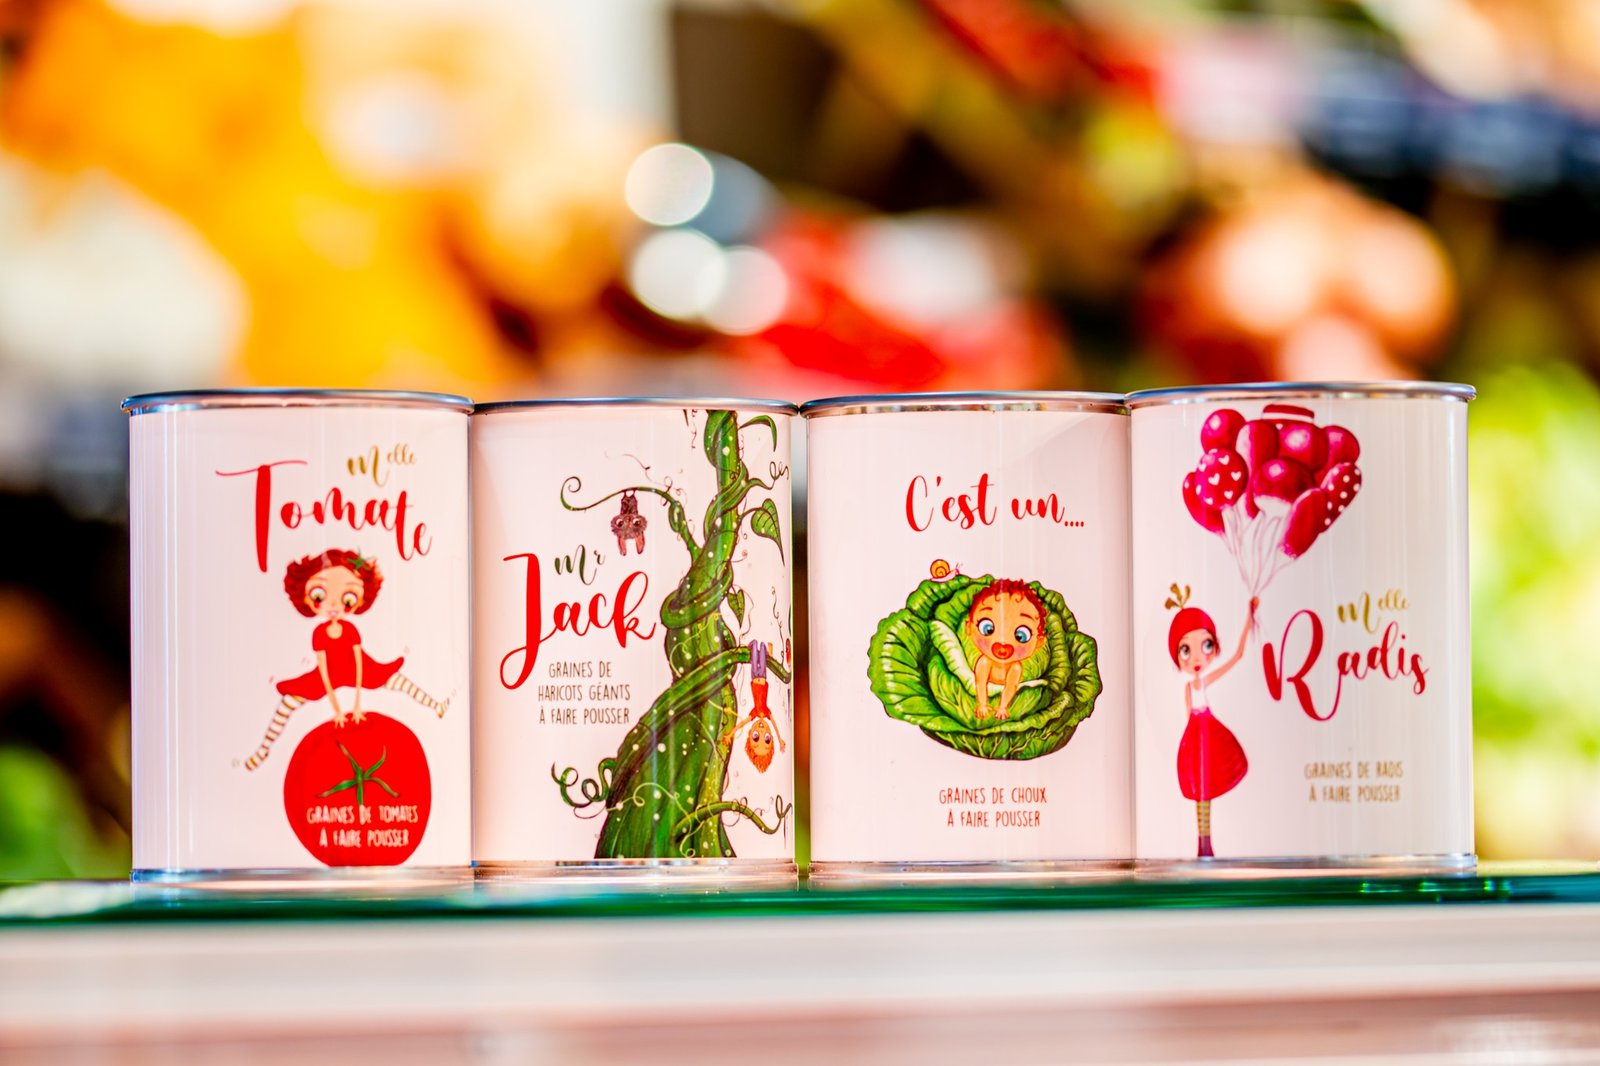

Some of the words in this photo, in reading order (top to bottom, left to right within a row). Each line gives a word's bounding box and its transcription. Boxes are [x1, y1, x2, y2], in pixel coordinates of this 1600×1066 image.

[905, 473, 997, 532] C'est
[215, 460, 432, 573] Tomate
[500, 553, 656, 690] Jack
[549, 660, 593, 678] GRAINES
[599, 660, 612, 678] DE
[1262, 621, 1429, 722] Radis
[538, 684, 583, 702] HARICOTS
[589, 682, 631, 701] GÉANTS
[551, 708, 577, 725] FAIRE
[584, 707, 630, 725] POUSSER
[1303, 761, 1352, 779] GRAINES
[1357, 761, 1369, 779] DE
[1375, 760, 1404, 779] RADIS
[939, 787, 986, 804] GRAINES
[992, 787, 1004, 804] DE
[1011, 787, 1047, 804] CHOUX
[1323, 784, 1351, 802] FAIRE
[1357, 784, 1400, 803] POUSSER
[306, 805, 355, 824] GRAINES
[359, 804, 371, 825] DE
[378, 805, 419, 823] TOMATES
[960, 810, 989, 827] FAIRE
[995, 810, 1040, 828] POUSSER
[333, 829, 361, 848] FAIRE
[367, 828, 409, 848] POUSSER
